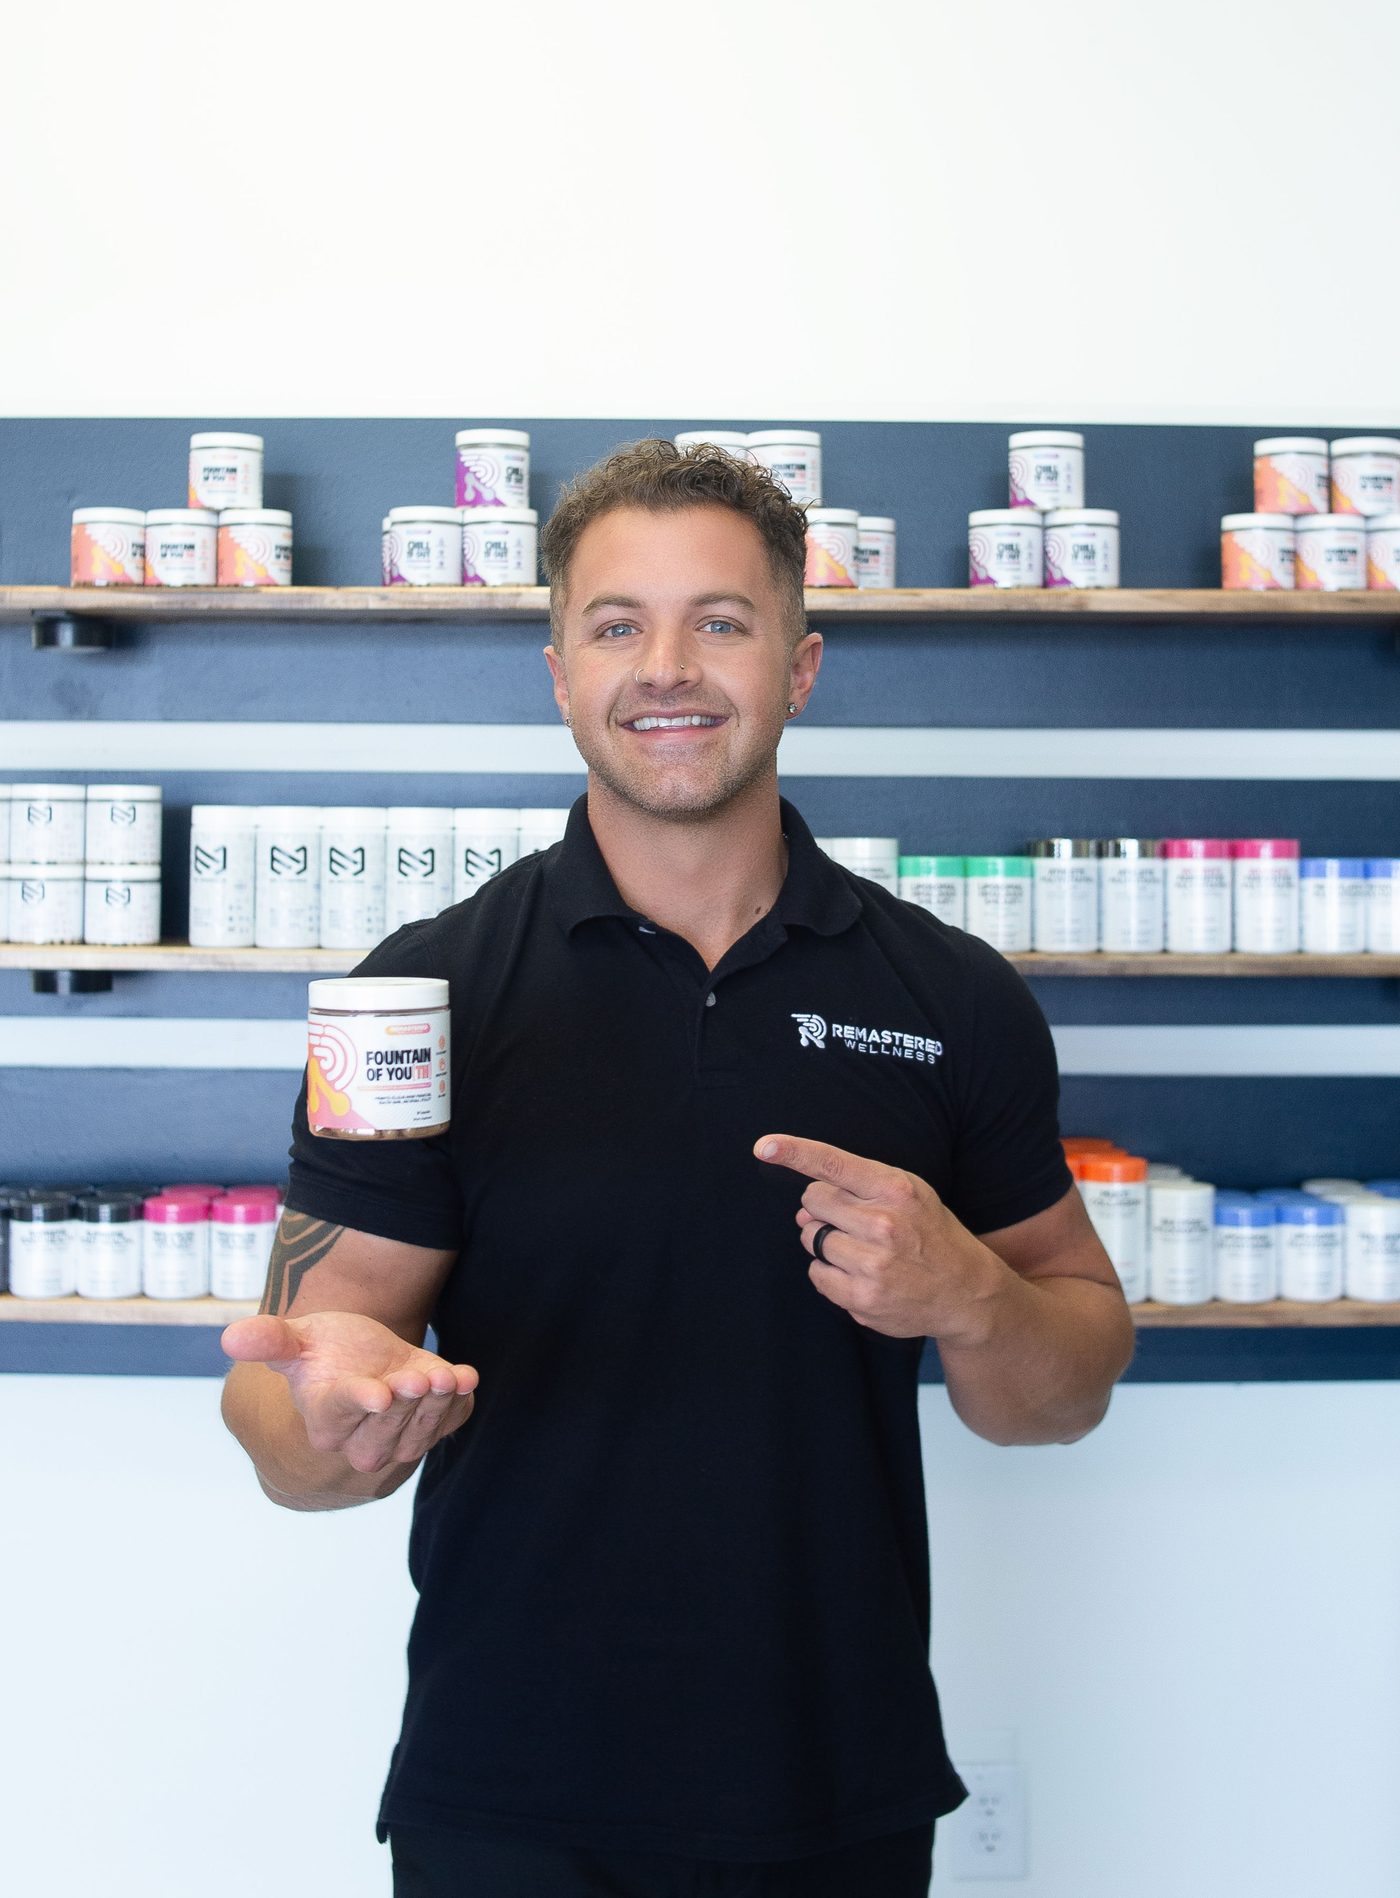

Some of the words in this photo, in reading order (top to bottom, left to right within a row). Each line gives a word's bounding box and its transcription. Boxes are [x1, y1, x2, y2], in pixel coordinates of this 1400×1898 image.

[832, 1023, 943, 1056] REMASTERED
[366, 1047, 431, 1065] FOUNTAIN
[844, 1038, 936, 1065] WELLNESS
[366, 1067, 384, 1081] OF
